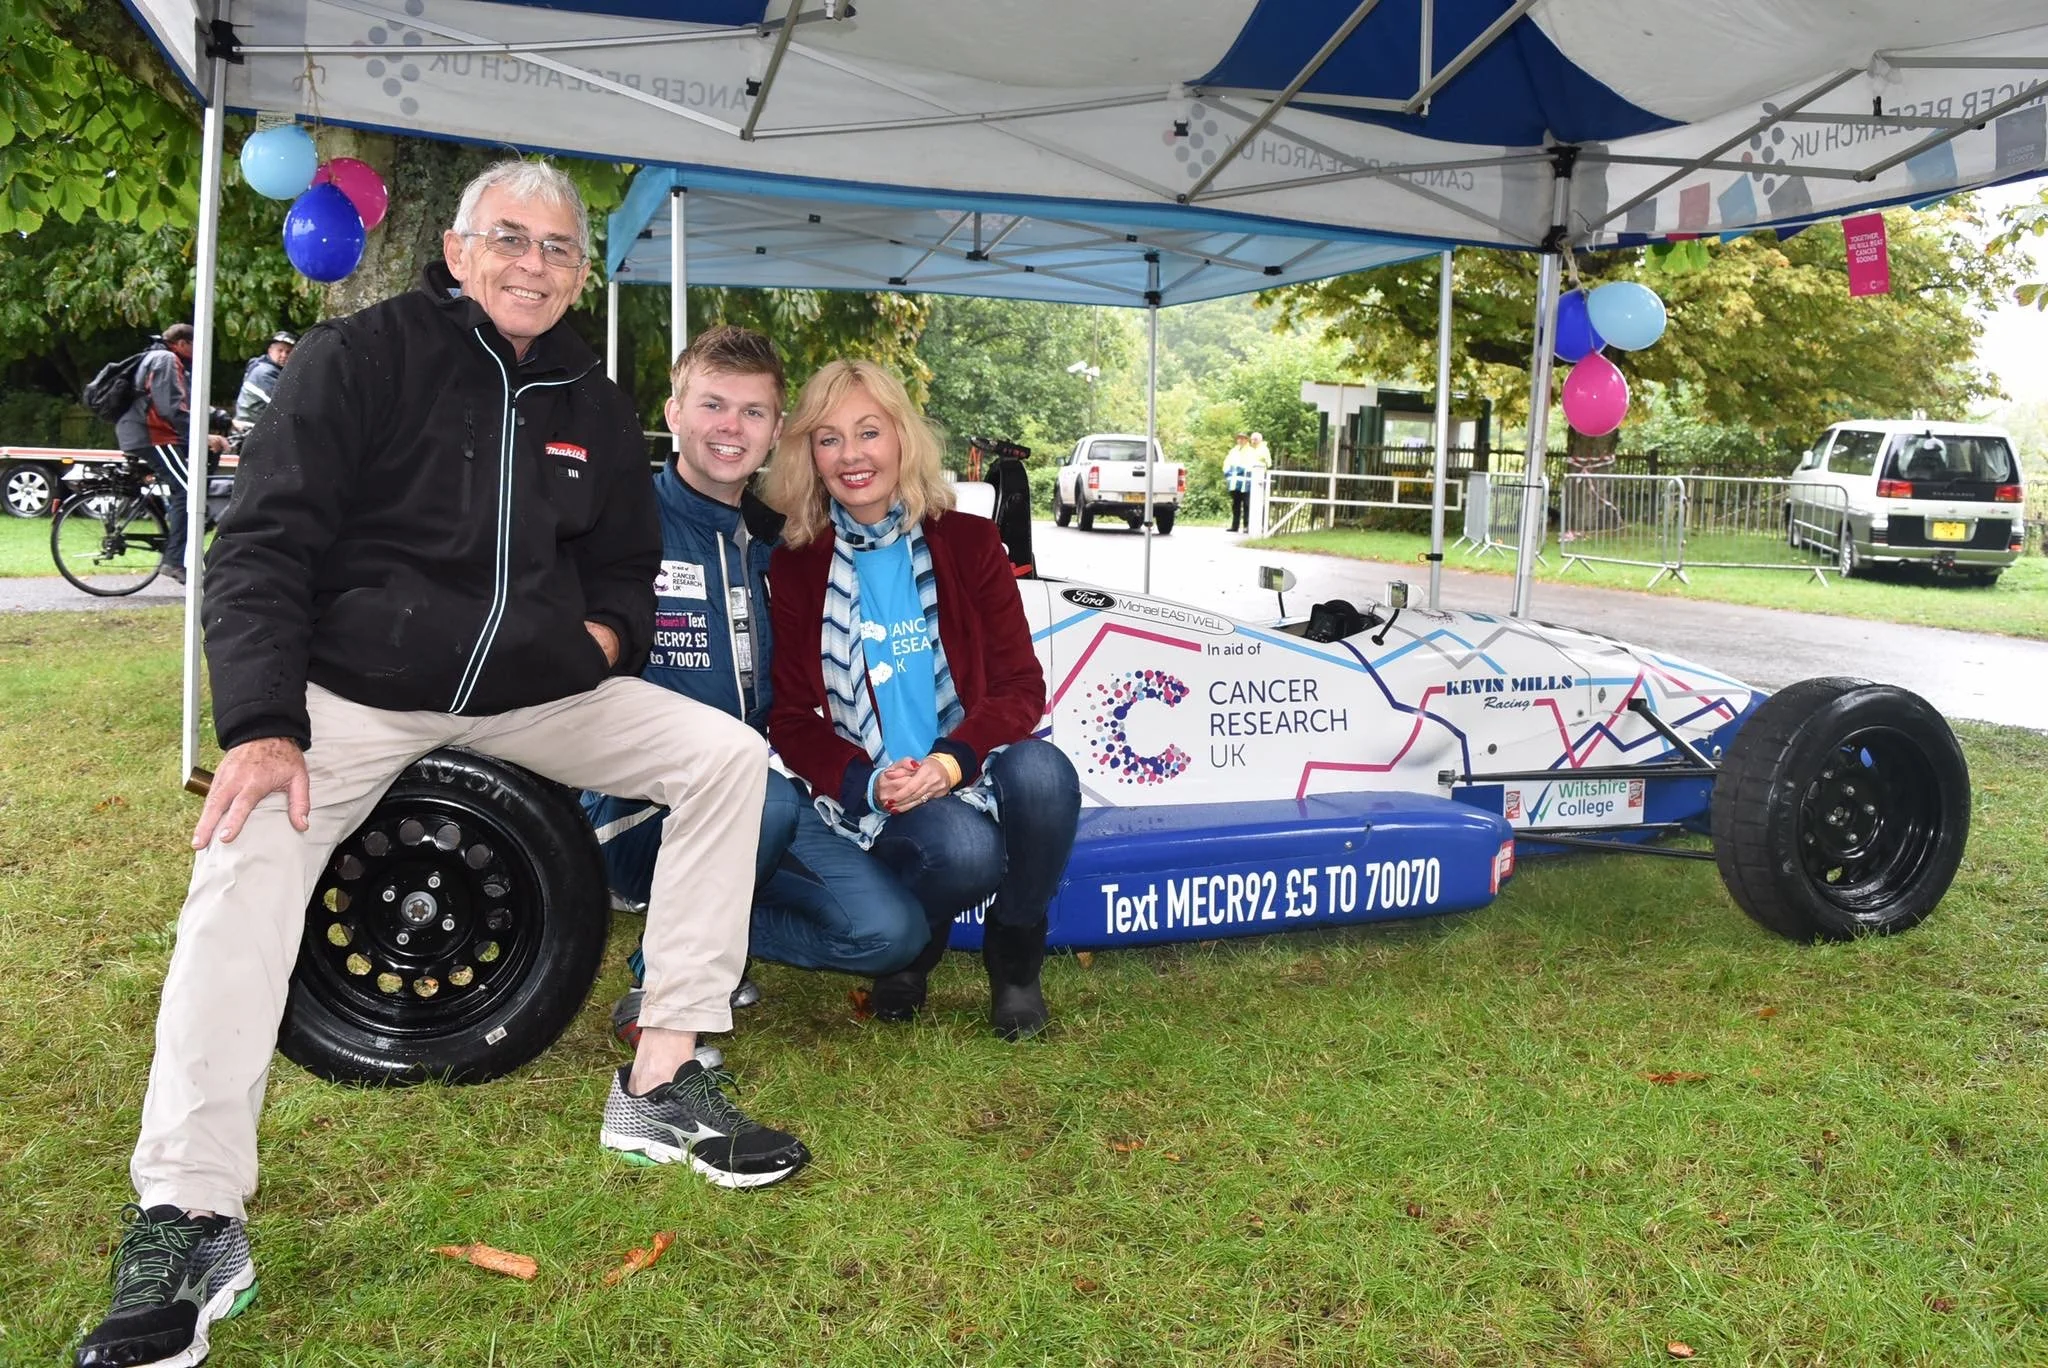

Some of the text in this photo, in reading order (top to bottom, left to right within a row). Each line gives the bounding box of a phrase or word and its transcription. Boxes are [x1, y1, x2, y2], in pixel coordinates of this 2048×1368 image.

[1855, 247, 1877, 256] CANCER
[545, 446, 587, 462] makita
[672, 572, 696, 580] CANCER
[672, 579, 703, 588] RESEARCH
[1072, 590, 1105, 607] Ford
[686, 612, 707, 628] Text
[1118, 599, 1224, 630] Michael EASTWELL
[889, 617, 927, 637] ANC
[694, 632, 708, 648] £5
[891, 636, 932, 656] ESEA
[1207, 642, 1261, 656] In aid of
[650, 651, 711, 668] to 70070
[895, 657, 907, 673] K
[1209, 679, 1319, 705] CANCER
[1446, 675, 1573, 696] KEVIN MILLS
[1483, 696, 1531, 711] Racing
[1210, 708, 1348, 737] RESEARCH
[1210, 743, 1246, 768] UK
[1558, 779, 1627, 798] Wiltshire
[1557, 799, 1614, 817] College
[1101, 883, 1159, 934] Text
[1167, 870, 1277, 929] MECR92
[1285, 867, 1318, 918] £5
[1325, 864, 1357, 914] TO
[1366, 857, 1441, 911] 70070
